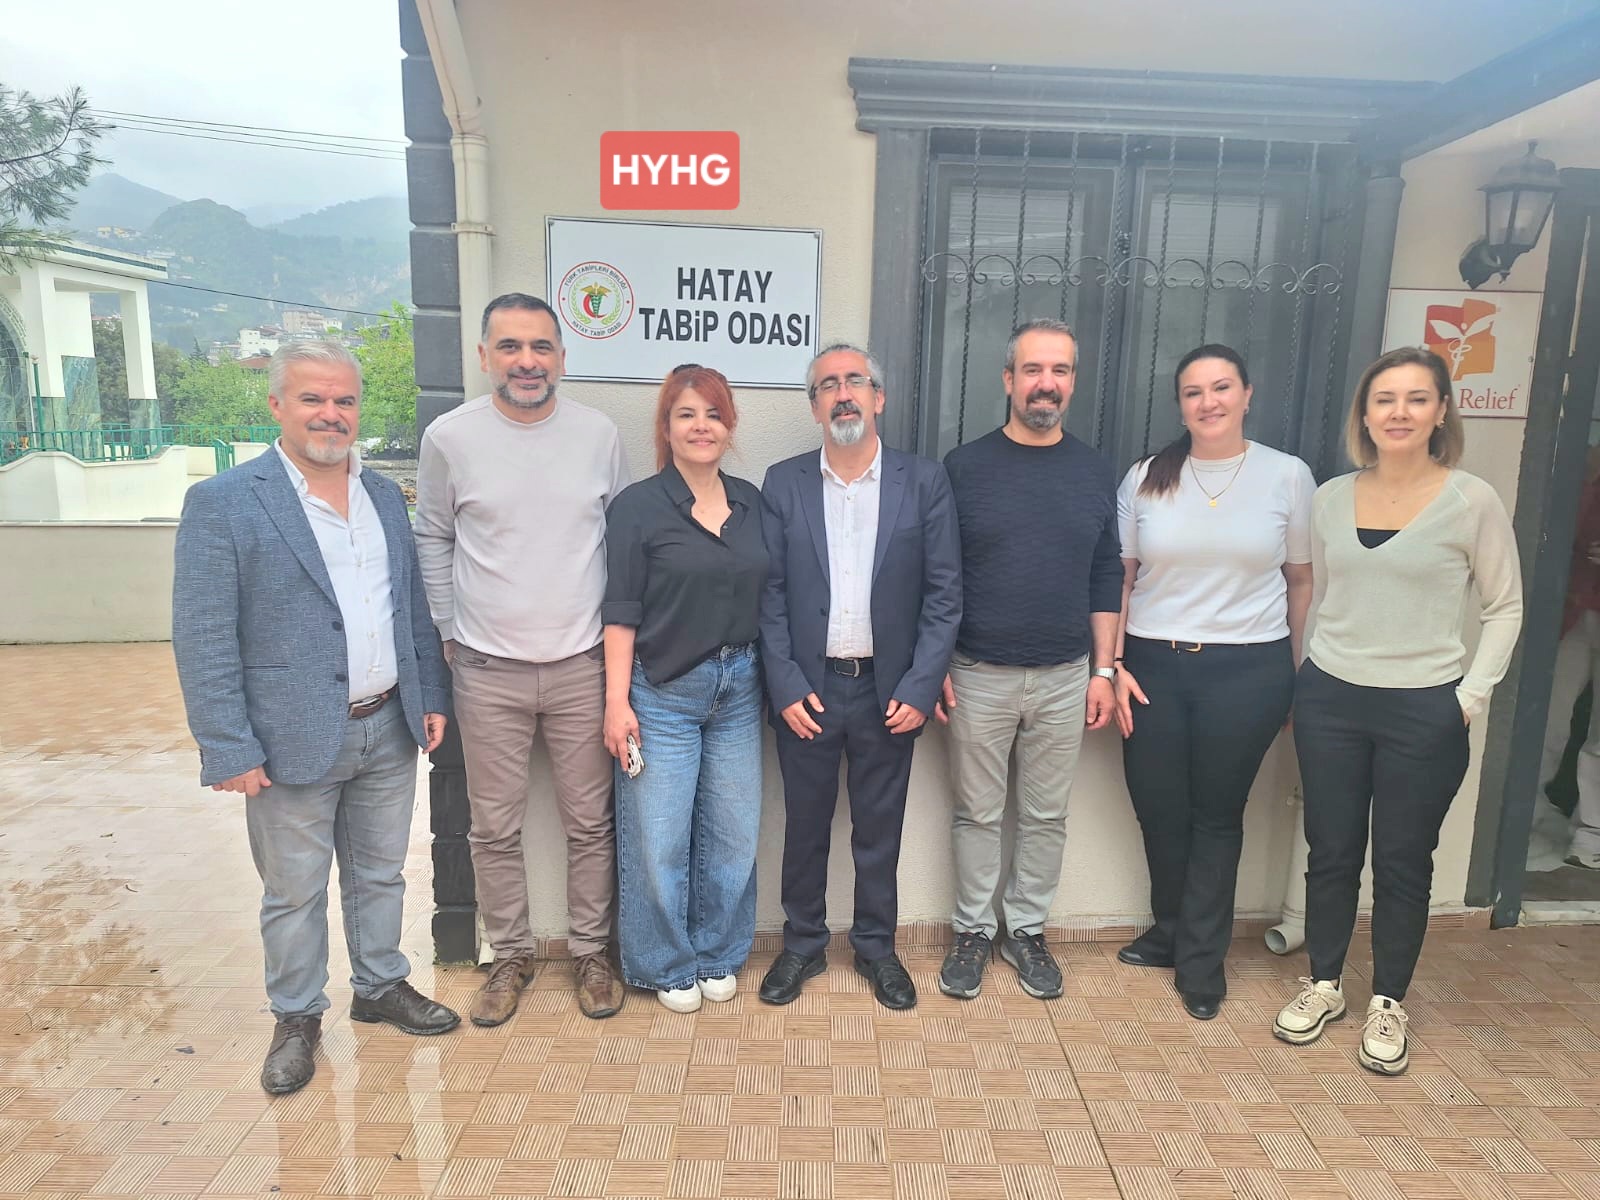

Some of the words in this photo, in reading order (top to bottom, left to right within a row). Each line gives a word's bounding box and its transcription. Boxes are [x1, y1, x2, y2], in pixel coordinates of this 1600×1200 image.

[677, 267, 773, 304] HATAY
[728, 310, 811, 347] ODASI
[1457, 387, 1519, 410] Relief
